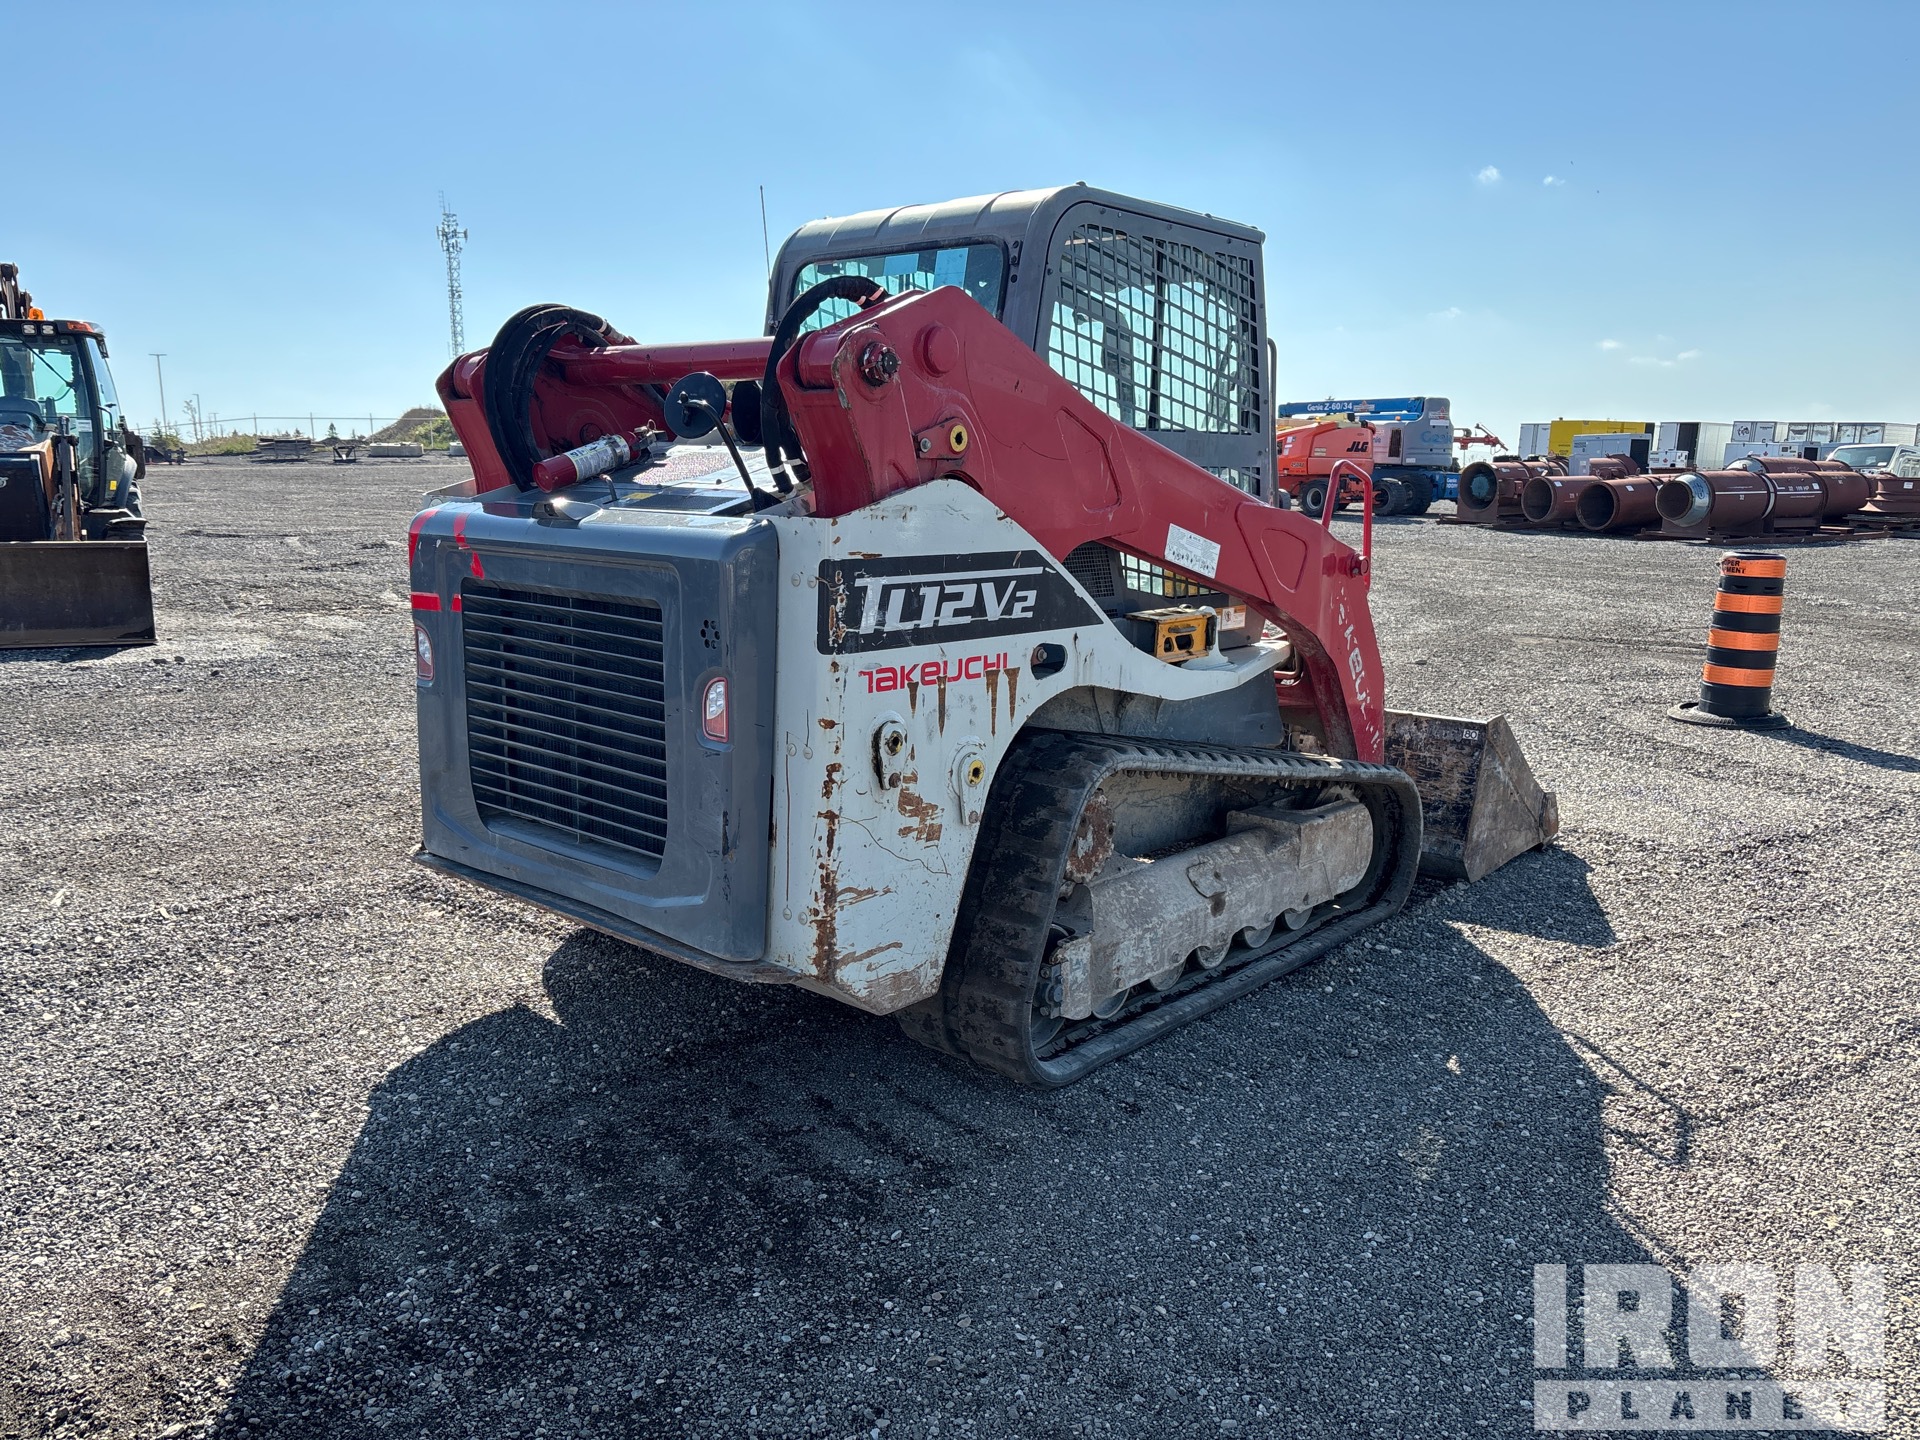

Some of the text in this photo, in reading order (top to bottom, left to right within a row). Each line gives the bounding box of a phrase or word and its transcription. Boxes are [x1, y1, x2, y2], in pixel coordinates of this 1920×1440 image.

[1307, 403, 1323, 411] Genie
[1324, 402, 1353, 411] Z-60/34
[1346, 441, 1369, 452] JLG
[858, 652, 1008, 694] TAKEUCHI
[1464, 730, 1477, 739] 80
